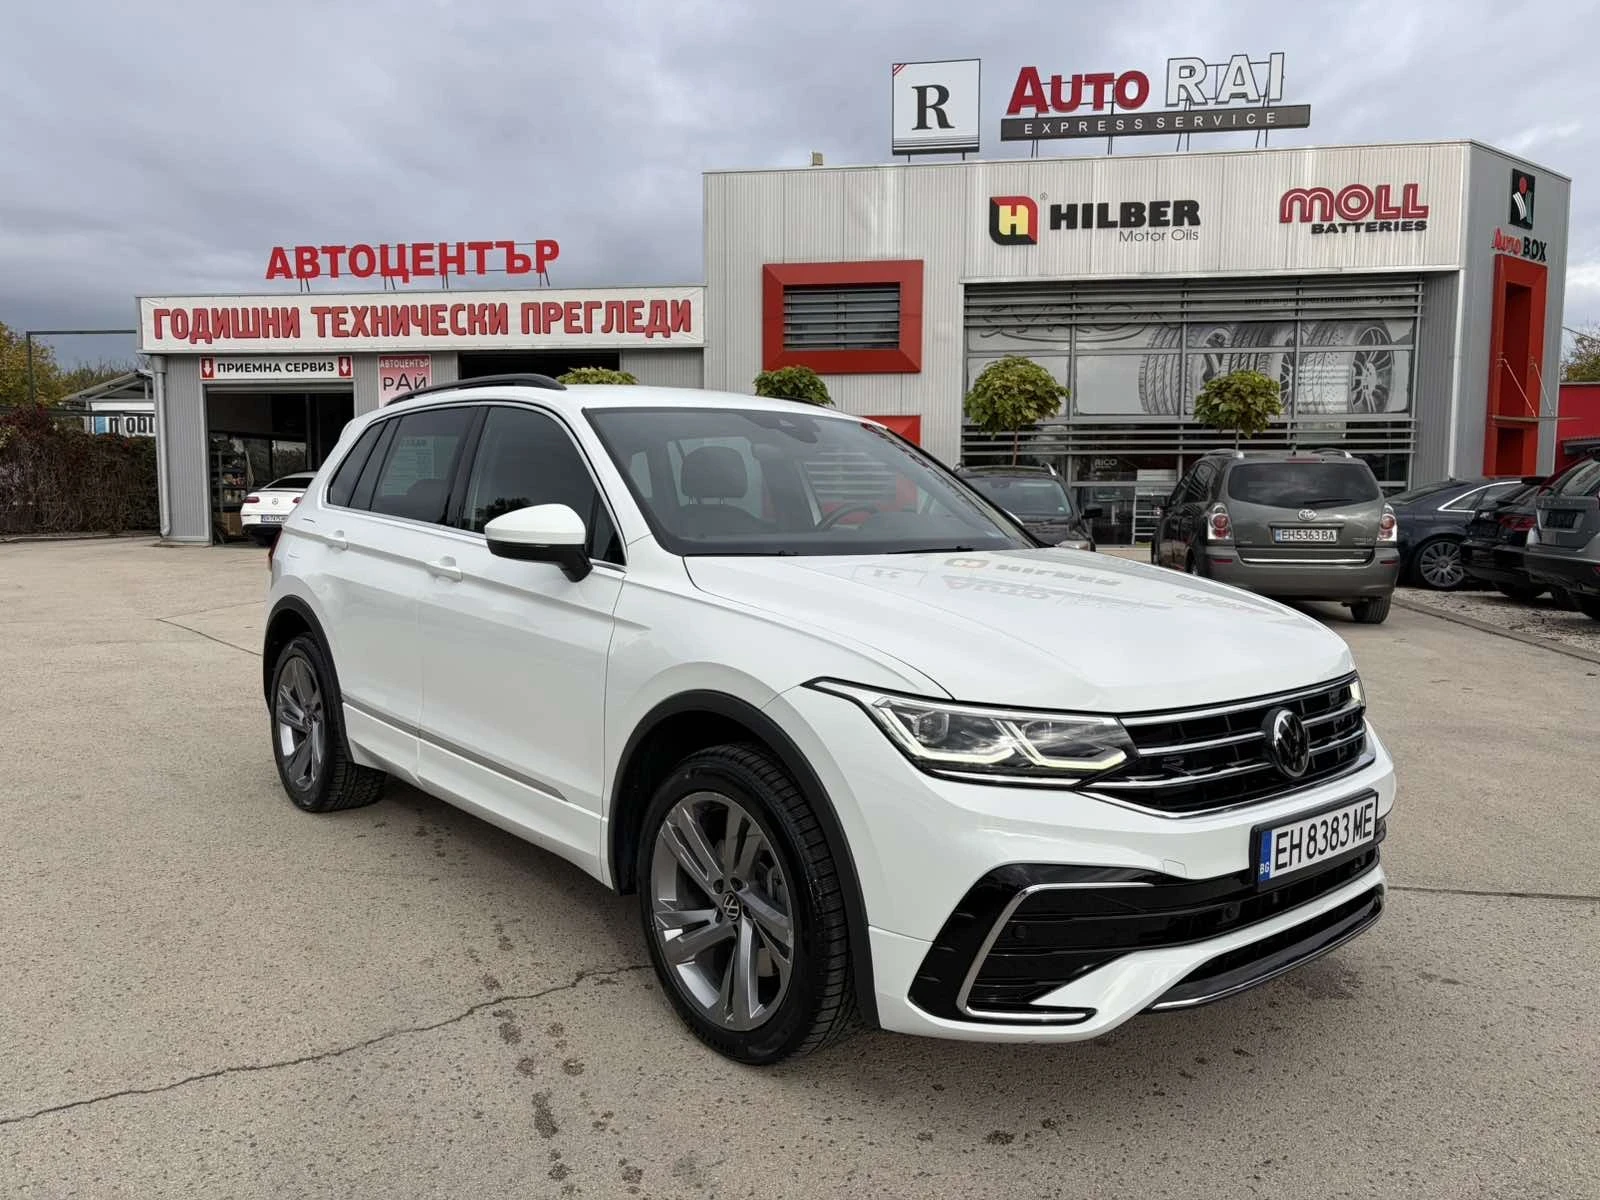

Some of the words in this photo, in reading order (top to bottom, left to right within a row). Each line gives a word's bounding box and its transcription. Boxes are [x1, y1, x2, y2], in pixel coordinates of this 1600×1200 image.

[1165, 52, 1285, 108] RAI
[911, 84, 955, 131] R
[1050, 200, 1201, 230] HILBER
[1311, 220, 1428, 234] BATTERIES
[1119, 229, 1167, 243] Motor
[1171, 228, 1199, 241] Oils
[1522, 236, 1547, 261] BOX
[266, 240, 560, 284] АВТОЦЕНТЪР
[153, 307, 300, 344] ГОДИШНИ
[310, 303, 508, 338] ТЕХНИЧЕСКИ
[521, 299, 692, 338] ПРЕГЛЕДИ
[217, 362, 281, 373] ПРИЕМНА
[285, 361, 335, 373] СЕРВИЗ
[379, 358, 429, 370] АВТОЦЕНТЪР
